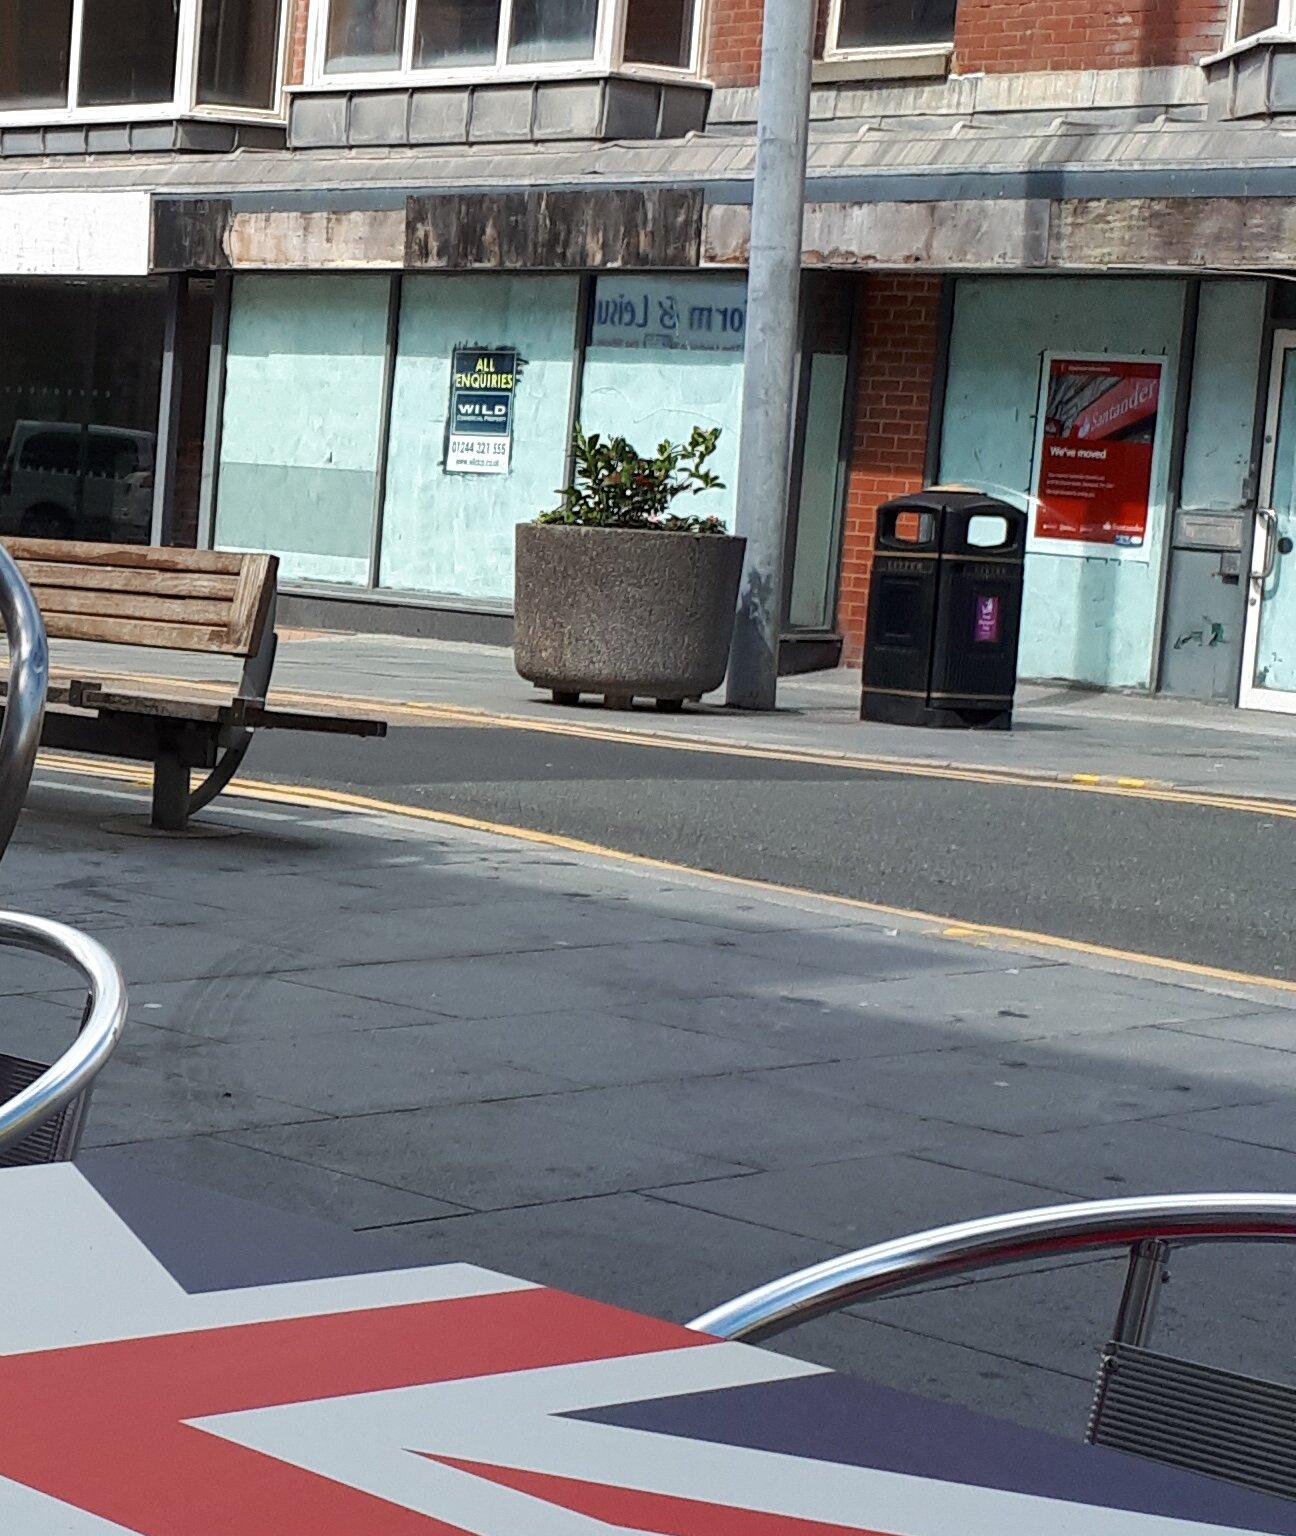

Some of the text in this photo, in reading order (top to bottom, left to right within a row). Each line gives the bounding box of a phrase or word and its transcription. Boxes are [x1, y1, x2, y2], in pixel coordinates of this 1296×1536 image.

[475, 357, 495, 373] ALL
[455, 373, 513, 389] ENQUIRIES
[458, 404, 506, 415] WILD
[1091, 380, 1158, 429] Santander
[1078, 449, 1106, 459] moved
